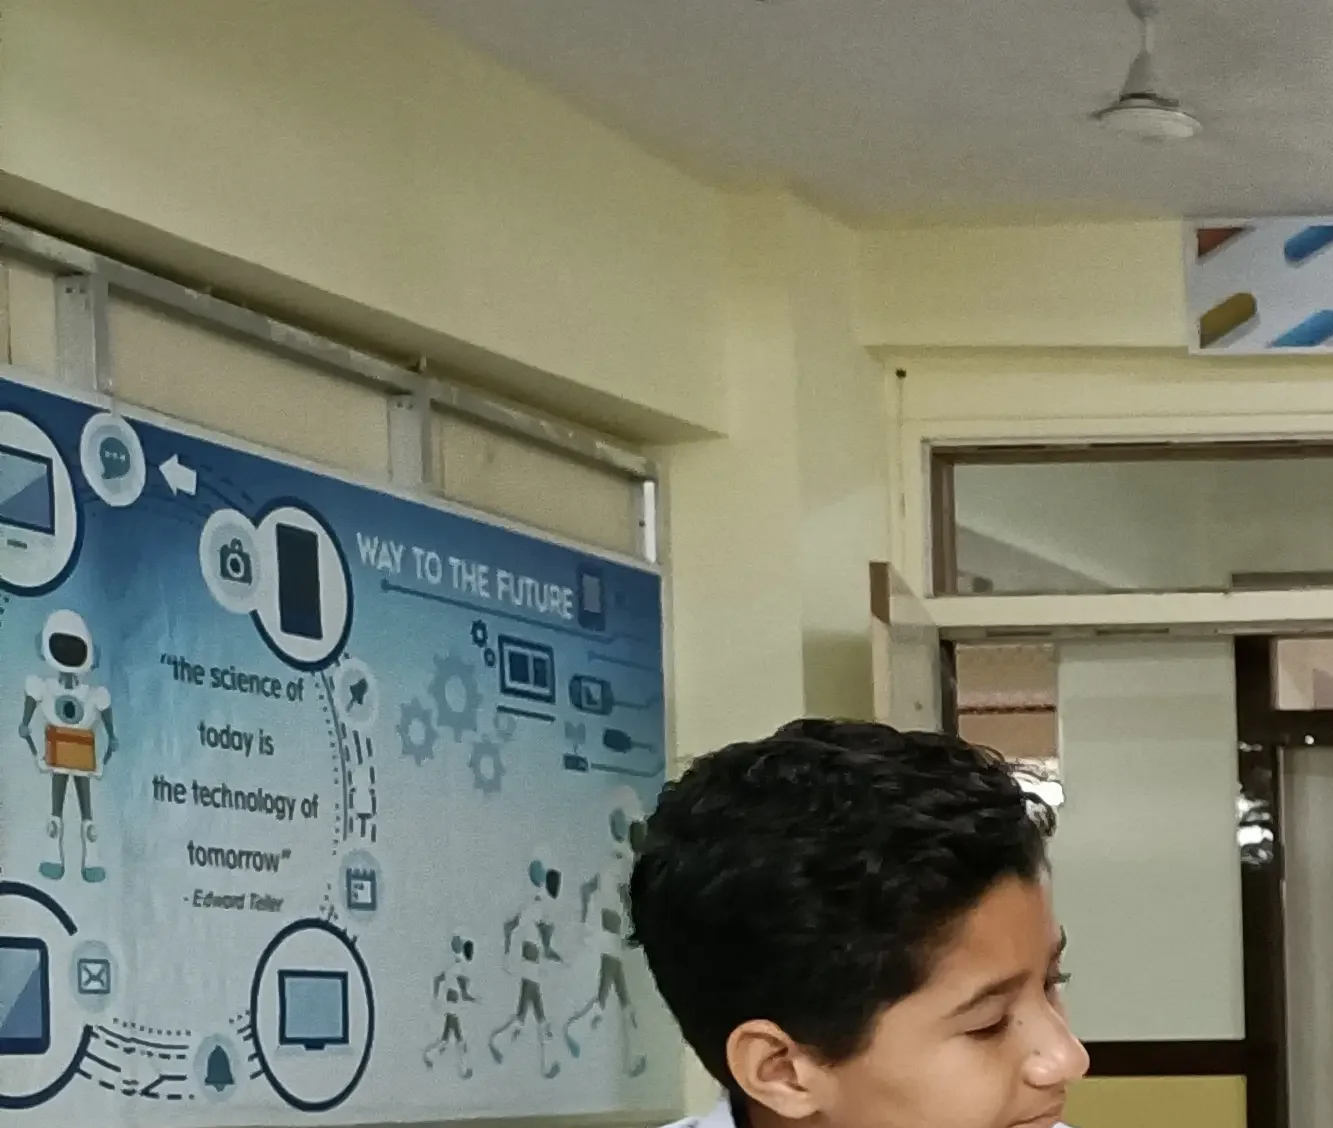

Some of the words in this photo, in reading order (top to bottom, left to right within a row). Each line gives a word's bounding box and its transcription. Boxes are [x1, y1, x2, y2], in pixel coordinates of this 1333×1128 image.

[356, 531, 404, 574] WAY
[411, 545, 443, 585] TO
[448, 555, 491, 599] THE
[496, 568, 575, 621] FUTURE
[210, 664, 283, 700] science
[286, 676, 304, 703] of
[197, 719, 254, 758] today
[258, 728, 275, 757] is
[152, 774, 188, 805] the
[191, 779, 297, 821] technology
[300, 793, 319, 820] of
